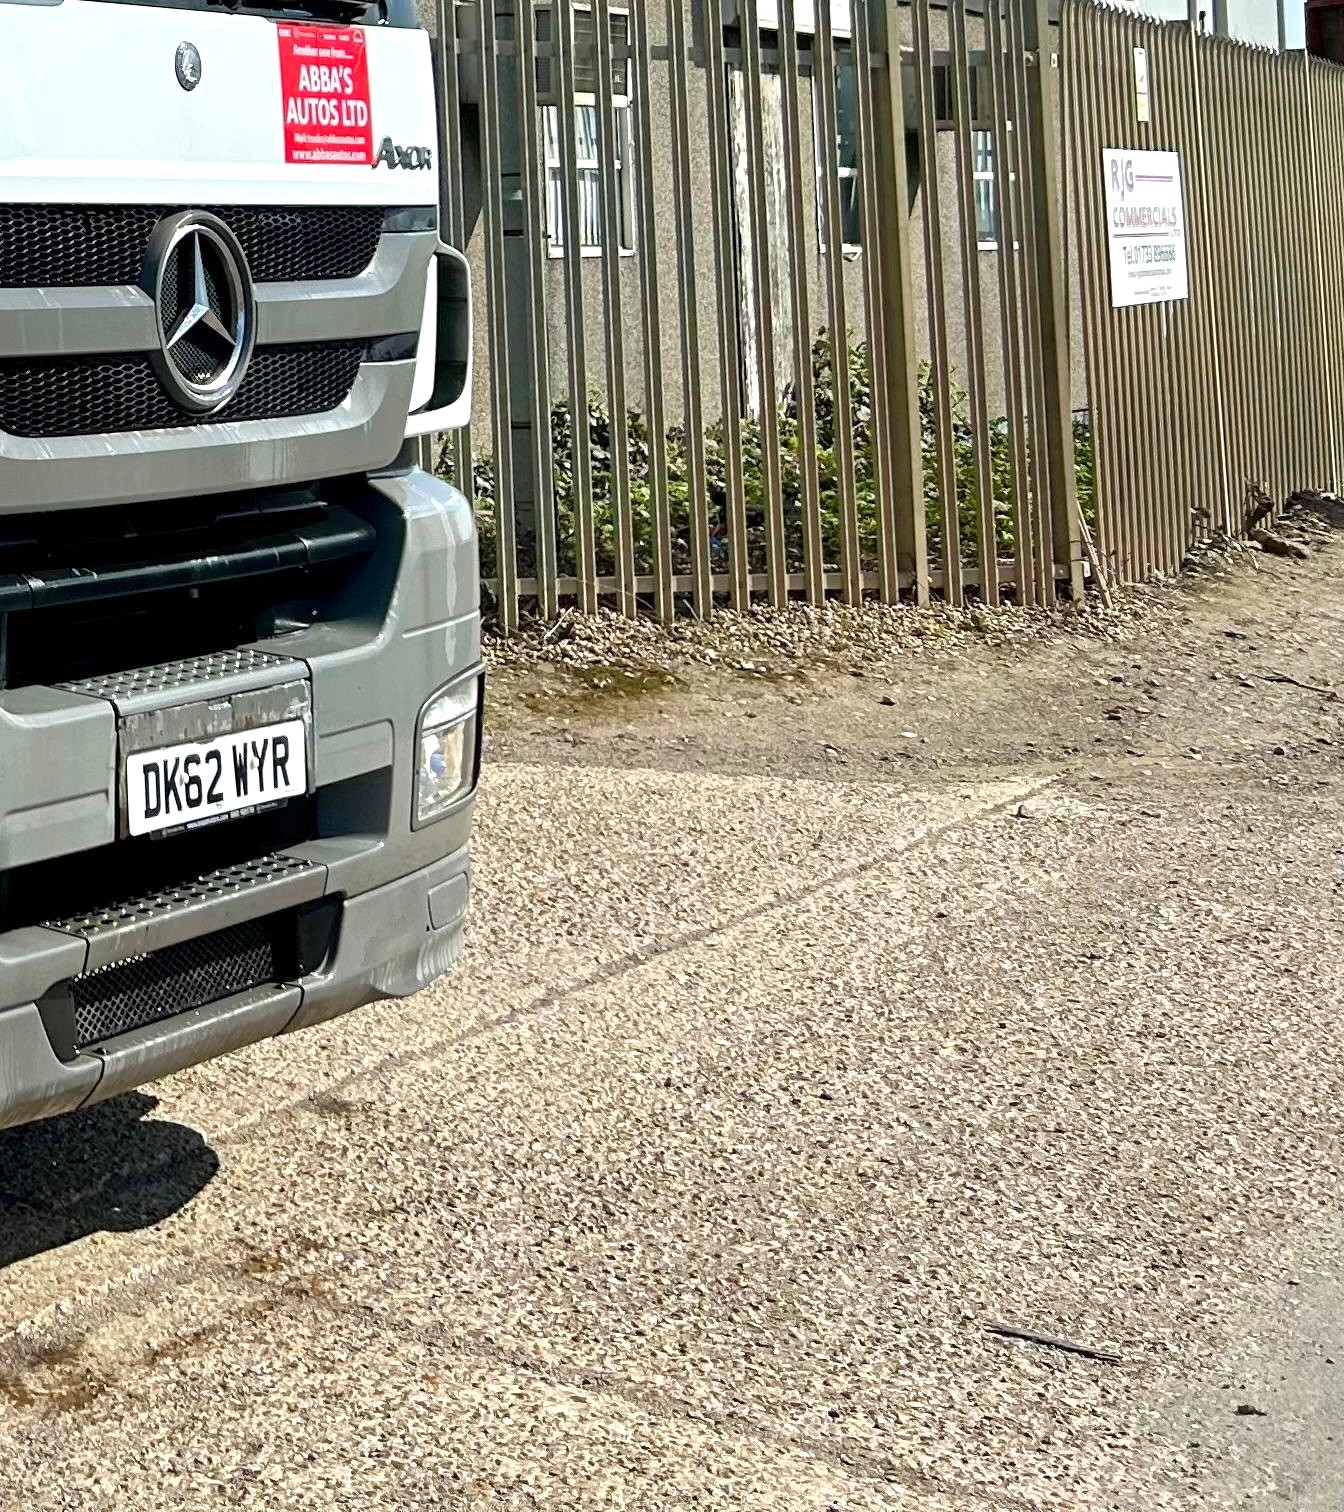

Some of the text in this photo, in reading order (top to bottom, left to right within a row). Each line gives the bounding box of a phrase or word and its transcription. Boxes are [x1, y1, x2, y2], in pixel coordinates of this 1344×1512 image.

[299, 64, 353, 94] ABBA'S
[287, 96, 368, 127] AUTOS LTD
[1110, 158, 1134, 201] RJG
[1113, 206, 1177, 228] COMMERCIALS
[142, 735, 291, 819] DK62 WYR
